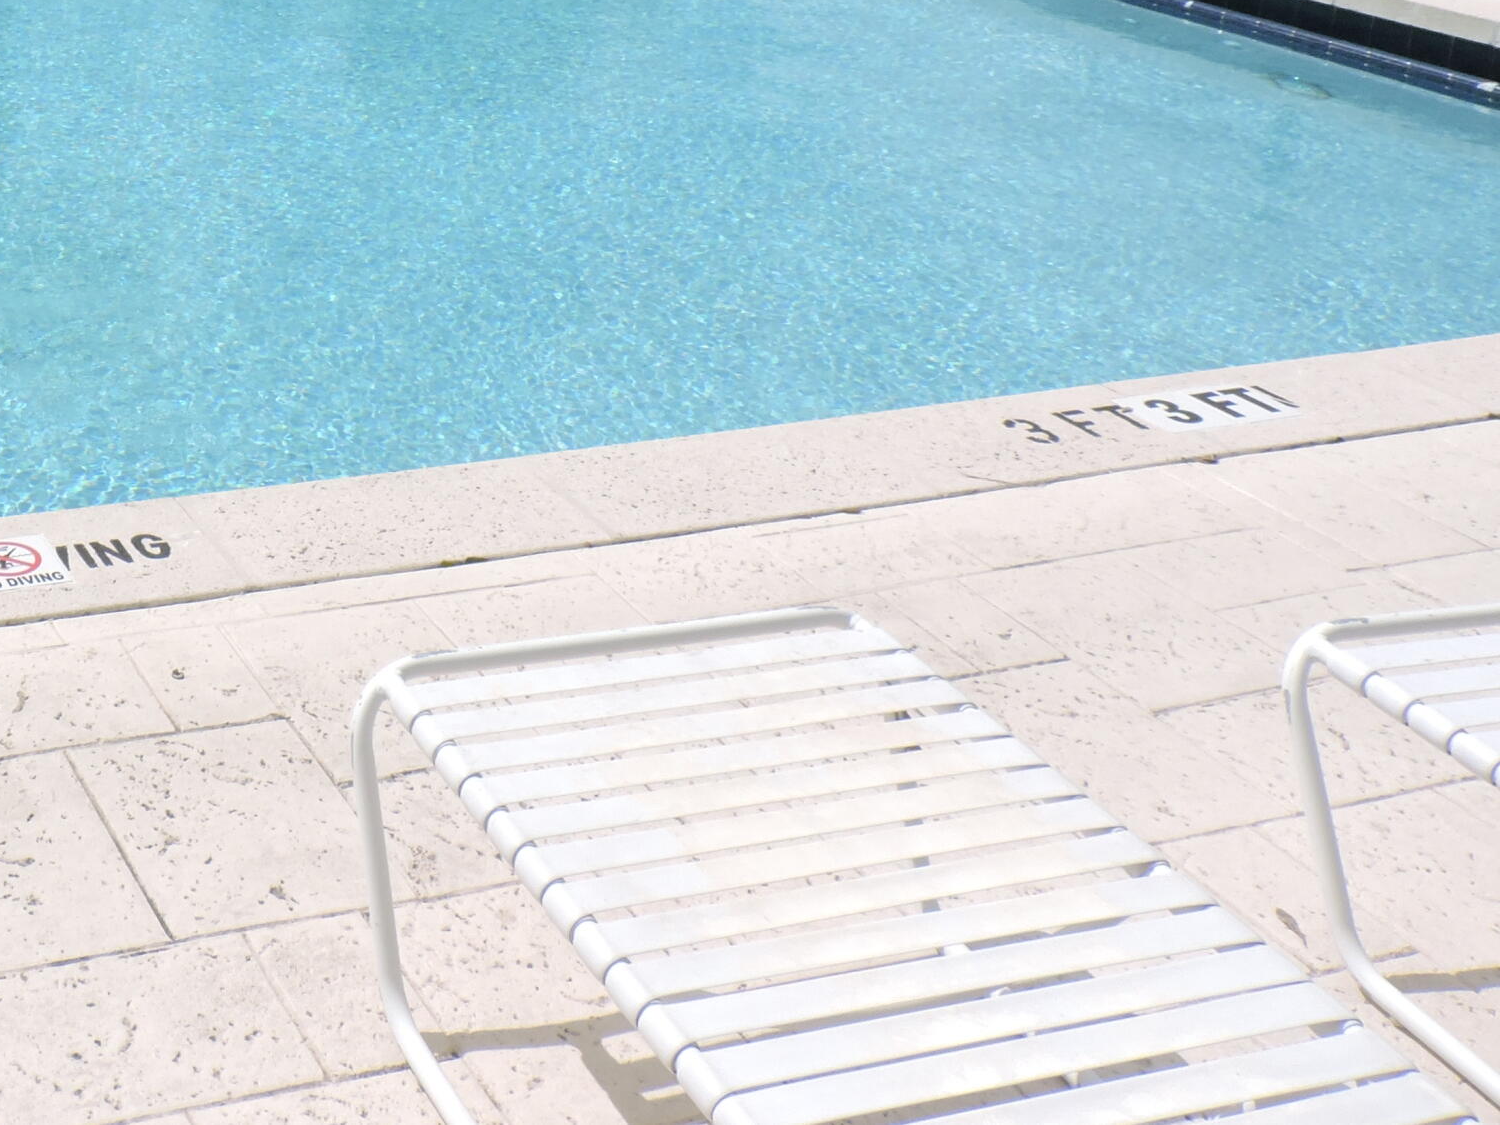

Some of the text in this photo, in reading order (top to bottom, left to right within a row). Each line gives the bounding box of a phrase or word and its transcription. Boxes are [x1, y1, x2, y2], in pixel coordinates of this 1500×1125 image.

[1144, 399, 1204, 424] 3
[1003, 405, 1150, 444] 3 FT
[6, 571, 65, 587] DIVING
